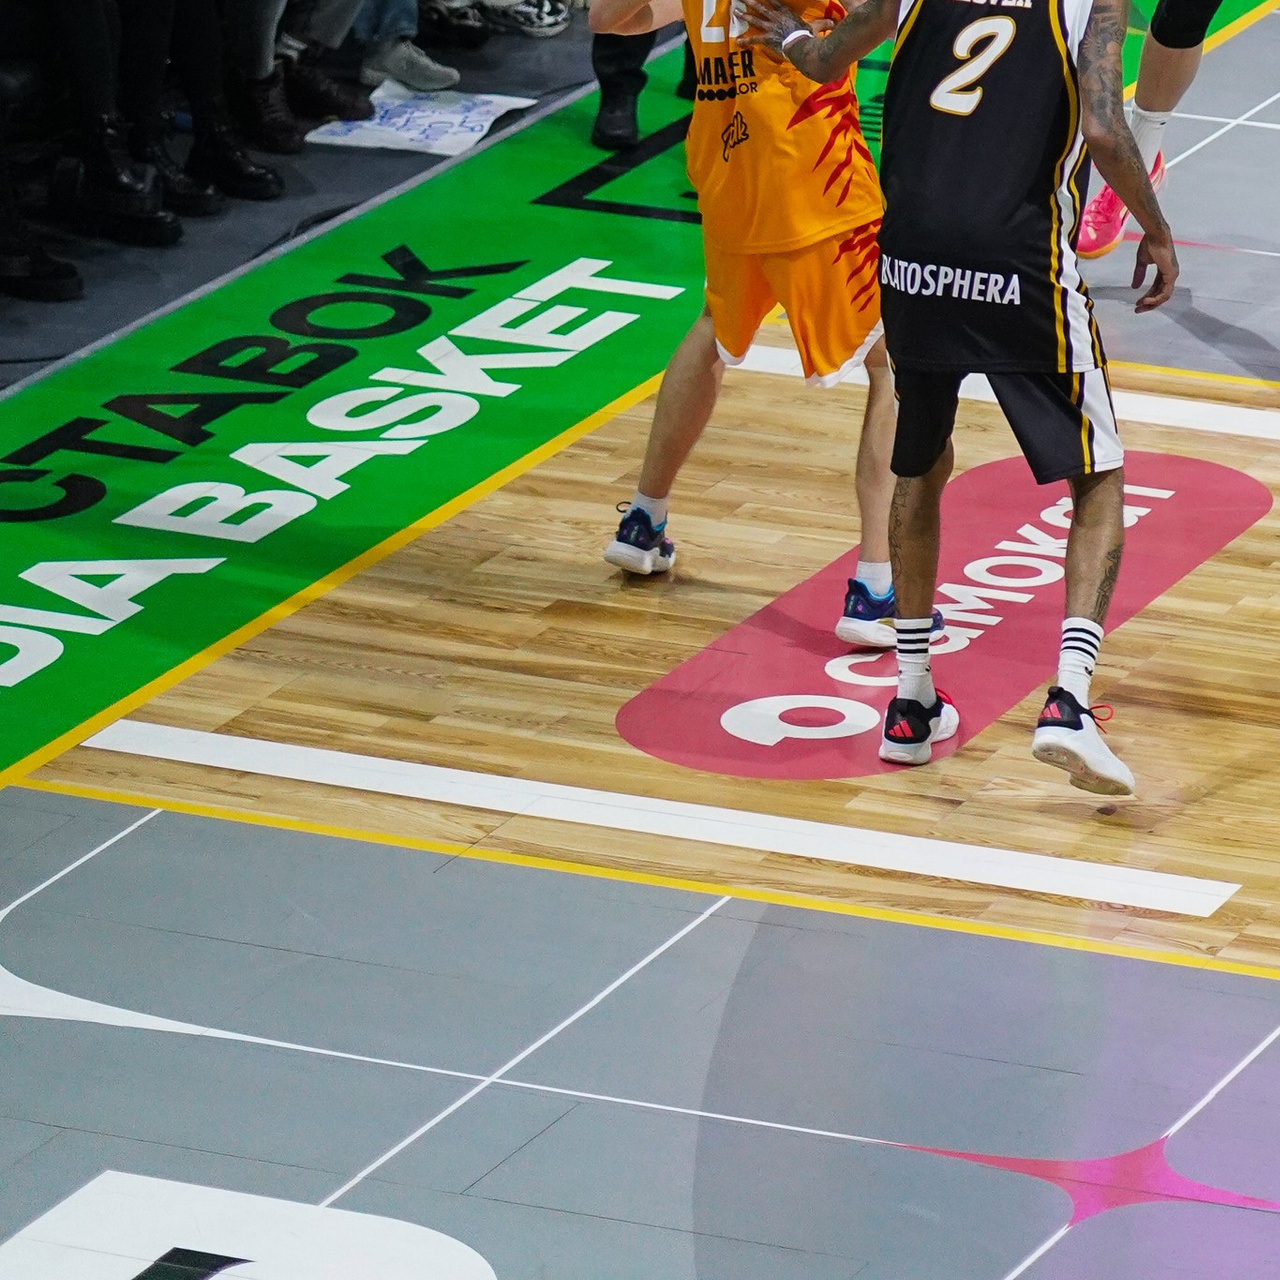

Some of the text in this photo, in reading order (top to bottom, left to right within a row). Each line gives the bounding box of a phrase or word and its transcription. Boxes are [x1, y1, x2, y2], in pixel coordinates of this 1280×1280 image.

[929, 15, 1017, 116] 2
[881, 253, 1021, 306] BLATOSPHERA
[111, 257, 685, 544] BASKET
